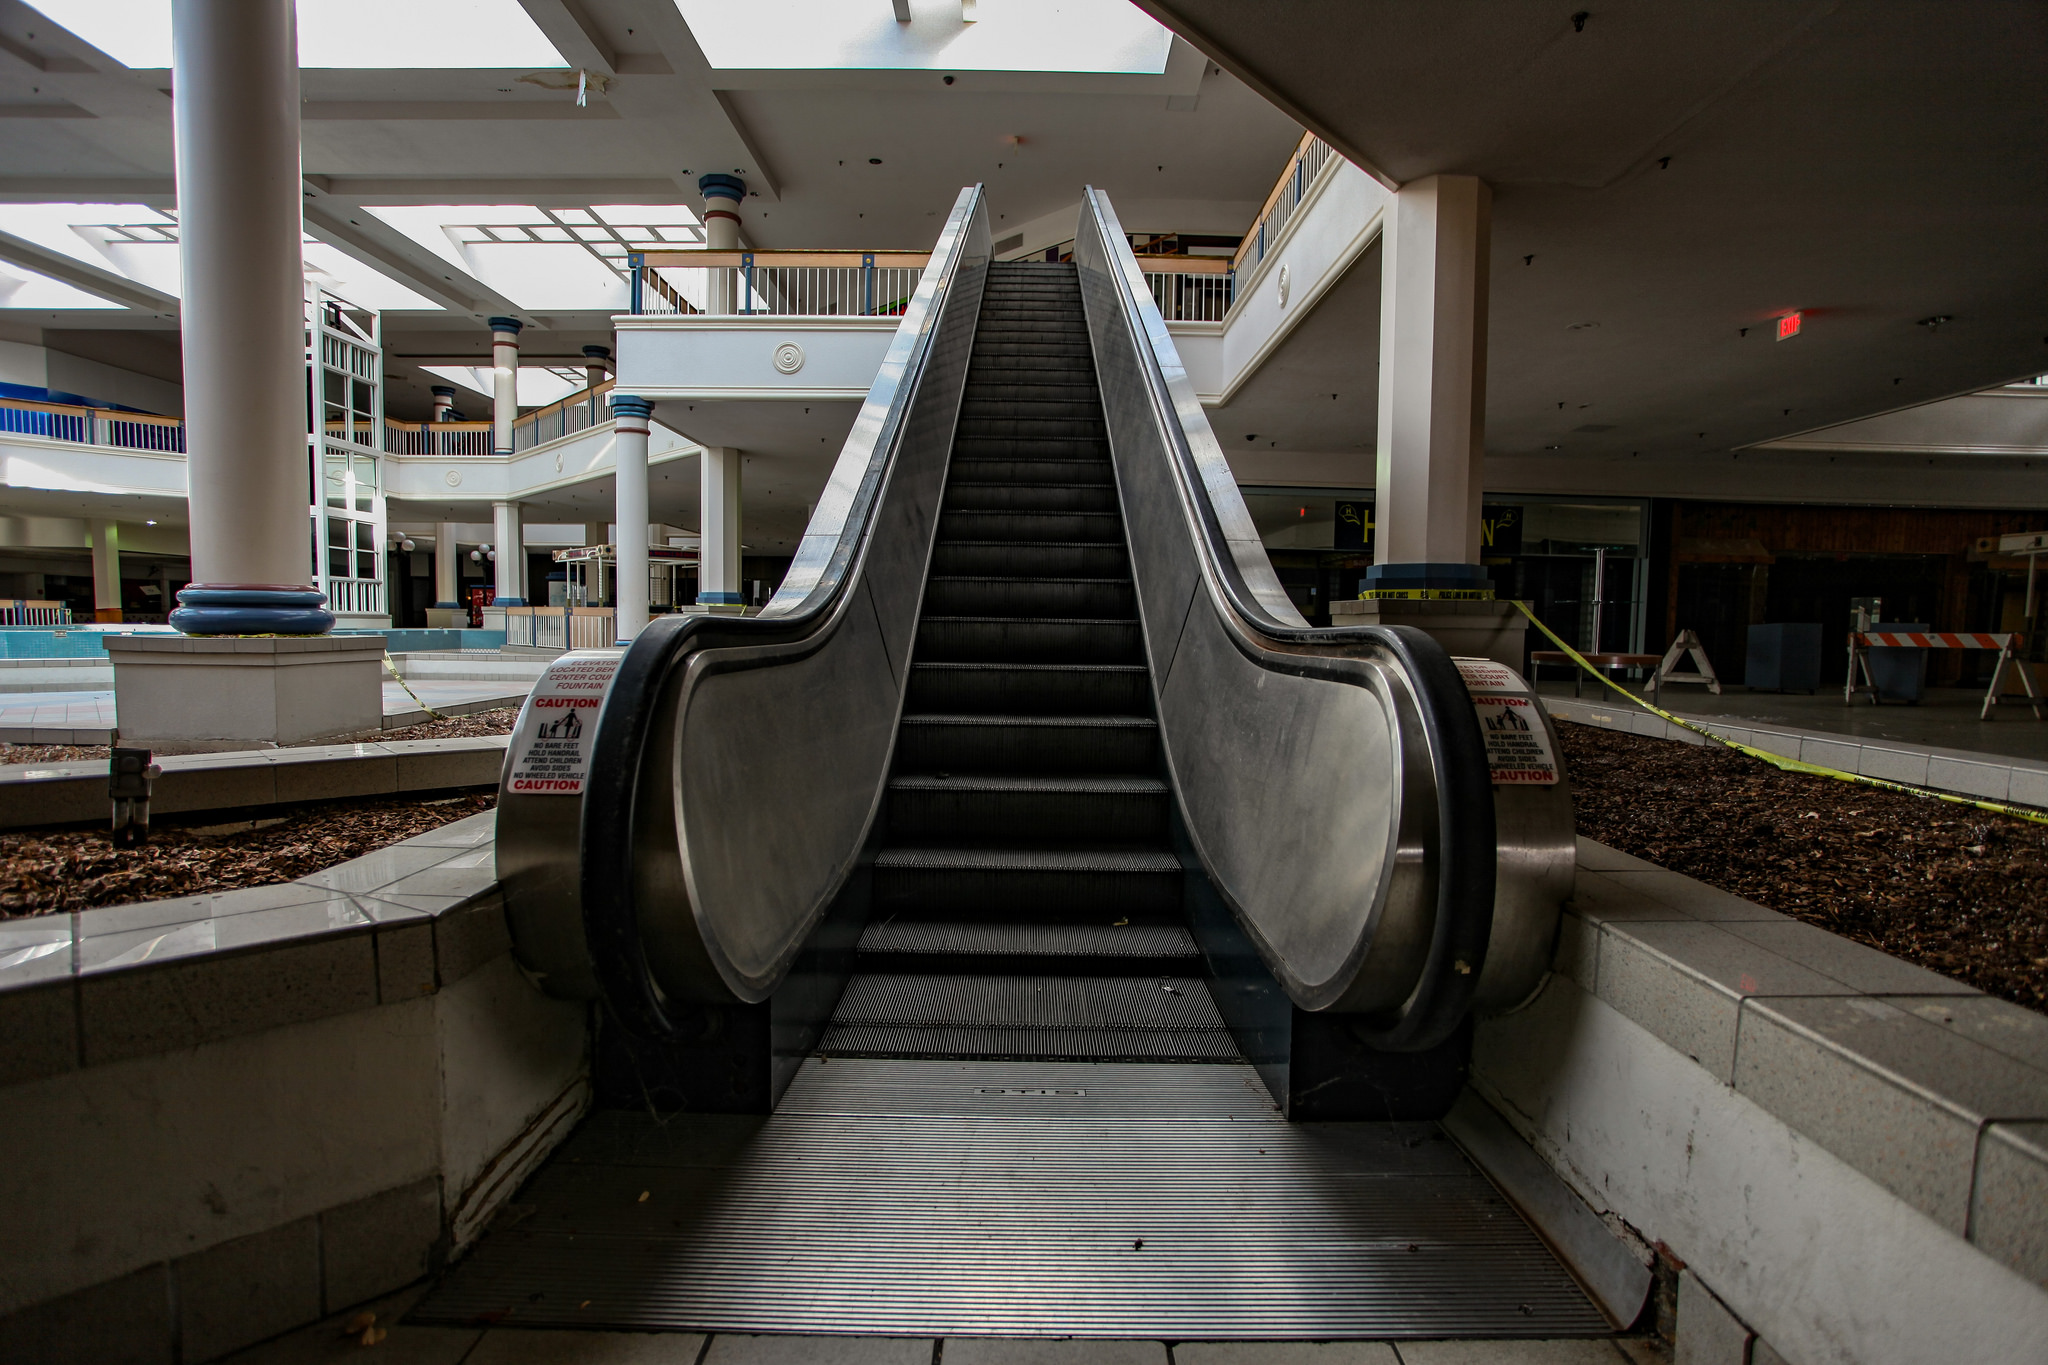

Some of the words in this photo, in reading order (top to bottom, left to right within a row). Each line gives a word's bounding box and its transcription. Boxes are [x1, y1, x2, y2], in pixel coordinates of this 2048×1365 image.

[1780, 314, 1800, 337] EXIT
[535, 698, 599, 708] CAUTION
[1528, 763, 1554, 771] VEHICLE
[557, 772, 585, 780] VEHICLE
[1490, 770, 1553, 781] CAUTION
[514, 780, 581, 790] CAUTION
